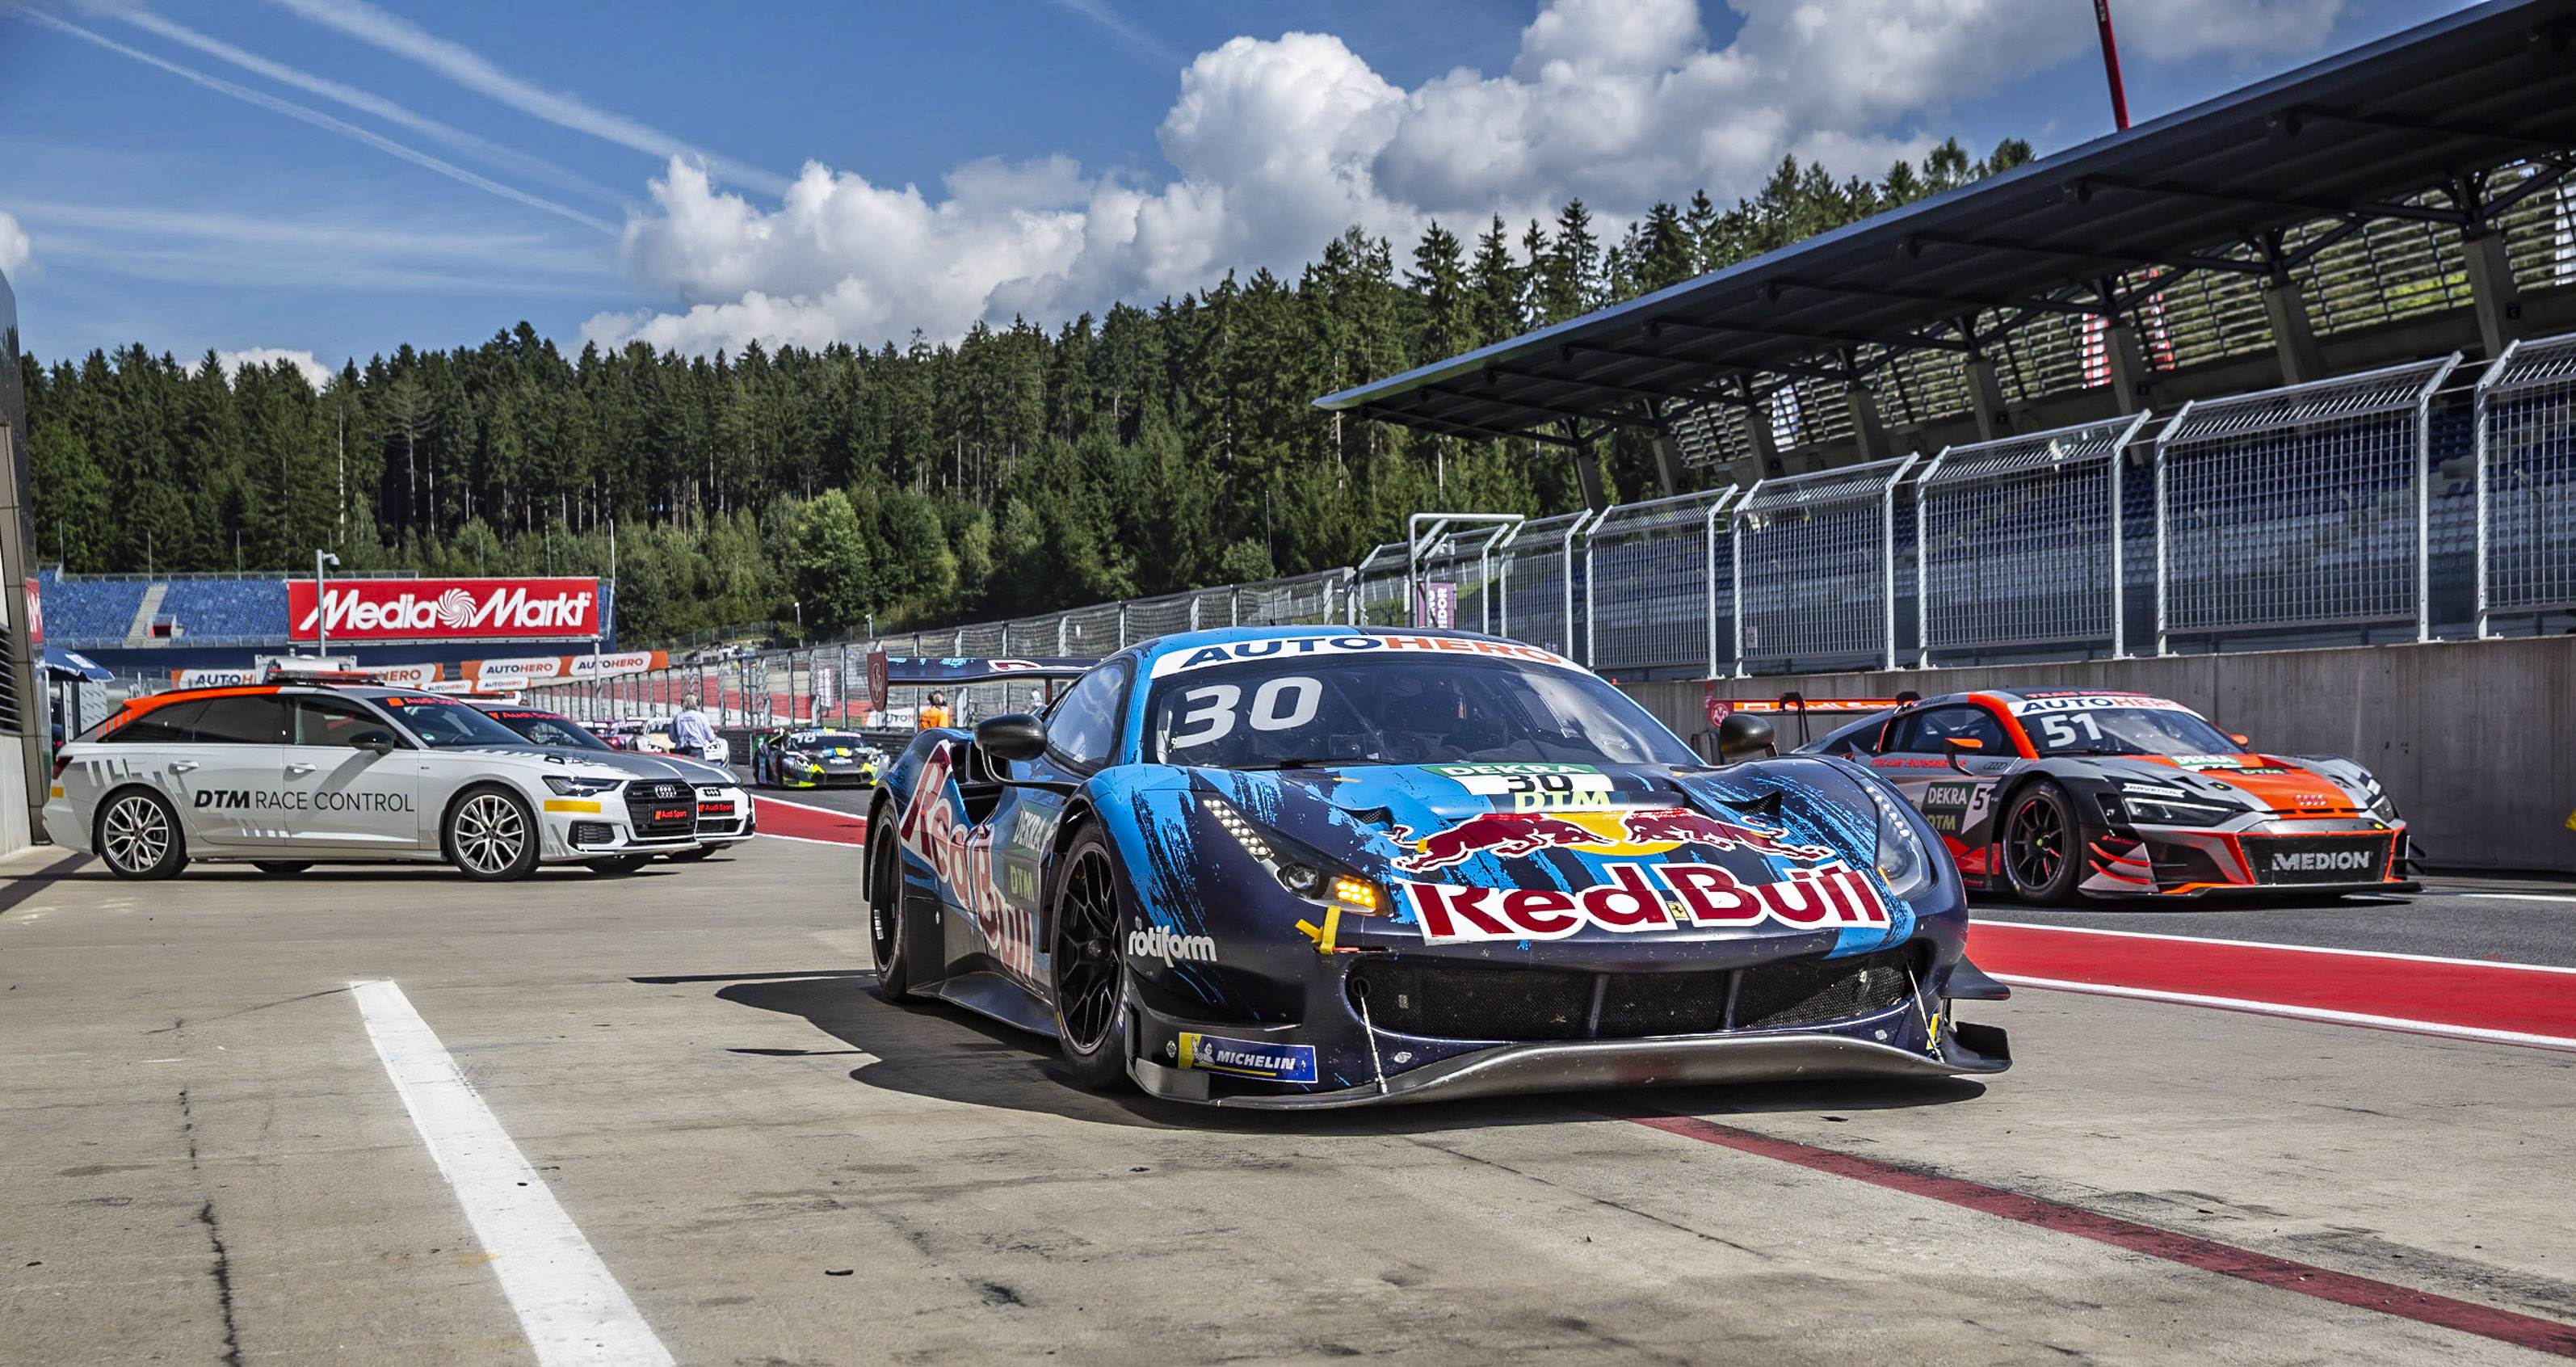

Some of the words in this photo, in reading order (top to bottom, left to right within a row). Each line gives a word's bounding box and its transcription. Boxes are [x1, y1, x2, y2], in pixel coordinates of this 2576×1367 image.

[300, 589, 437, 631] Media
[472, 587, 590, 628] Markt
[1179, 637, 1562, 669] AUTOHERO
[486, 662, 553, 675] AUTOHERO
[1172, 676, 1324, 750] 30
[2040, 713, 2103, 747] 51
[1440, 764, 1590, 776] DEKRA
[1501, 774, 1574, 794] 30
[194, 790, 250, 809] DTM
[255, 791, 308, 810] RACE
[314, 792, 414, 812] CONTROL
[1515, 790, 1613, 814] DTM
[1927, 787, 1968, 805] DEKRA
[1973, 788, 1990, 811] 5
[662, 810, 674, 818] Audi
[1927, 814, 1956, 831] DTM
[1012, 810, 1041, 852] DEKRA
[2271, 852, 2370, 870] MEDION
[1010, 864, 1035, 902] DTM
[1399, 862, 1672, 941] Red
[1658, 860, 1890, 929] Bull
[1128, 925, 1217, 968] rotiform
[1217, 1050, 1296, 1070] MICHELIN
